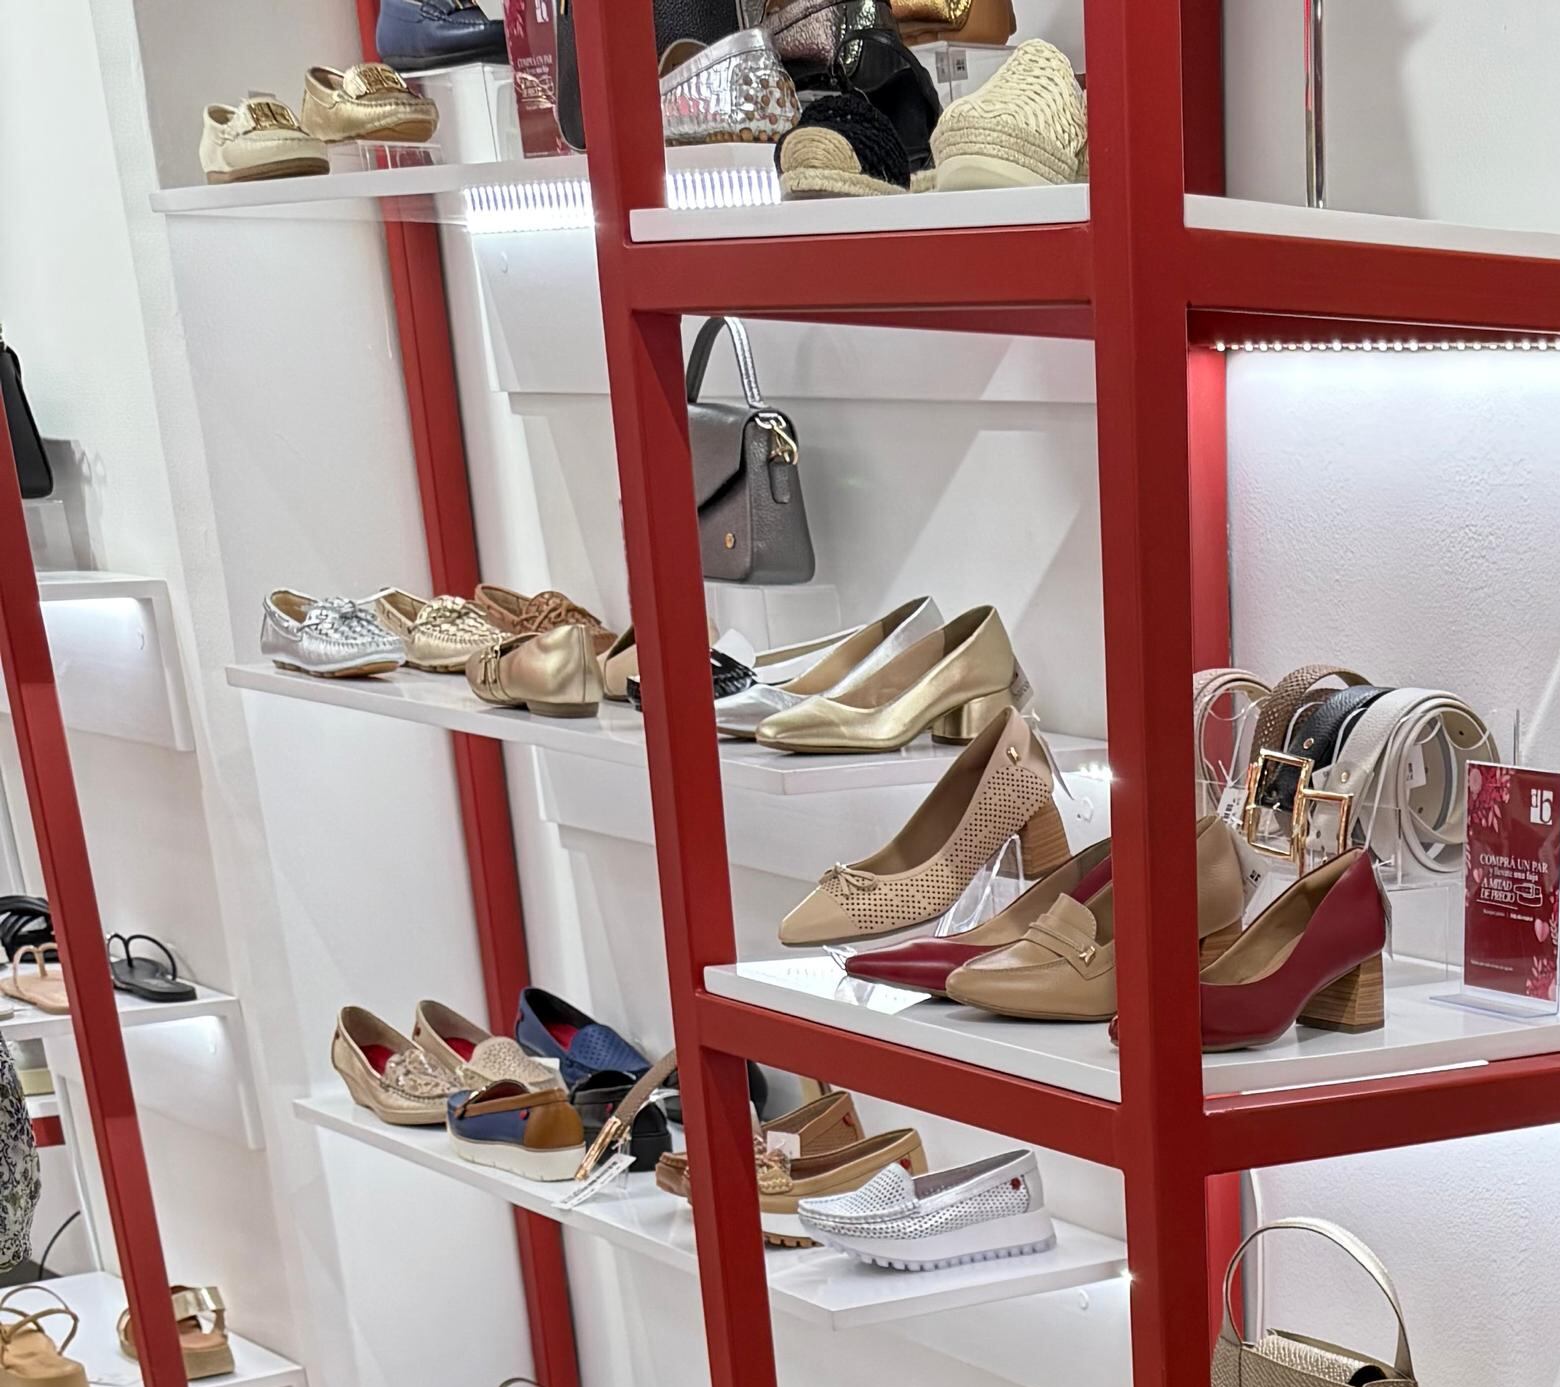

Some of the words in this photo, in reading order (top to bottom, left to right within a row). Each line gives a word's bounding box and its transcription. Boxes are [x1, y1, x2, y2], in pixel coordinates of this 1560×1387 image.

[1480, 853, 1515, 869] COMPRÁ
[1517, 858, 1530, 871] UN
[1532, 861, 1548, 873] PAR
[1489, 878, 1512, 891] MITAD
[1480, 888, 1490, 899] DE
